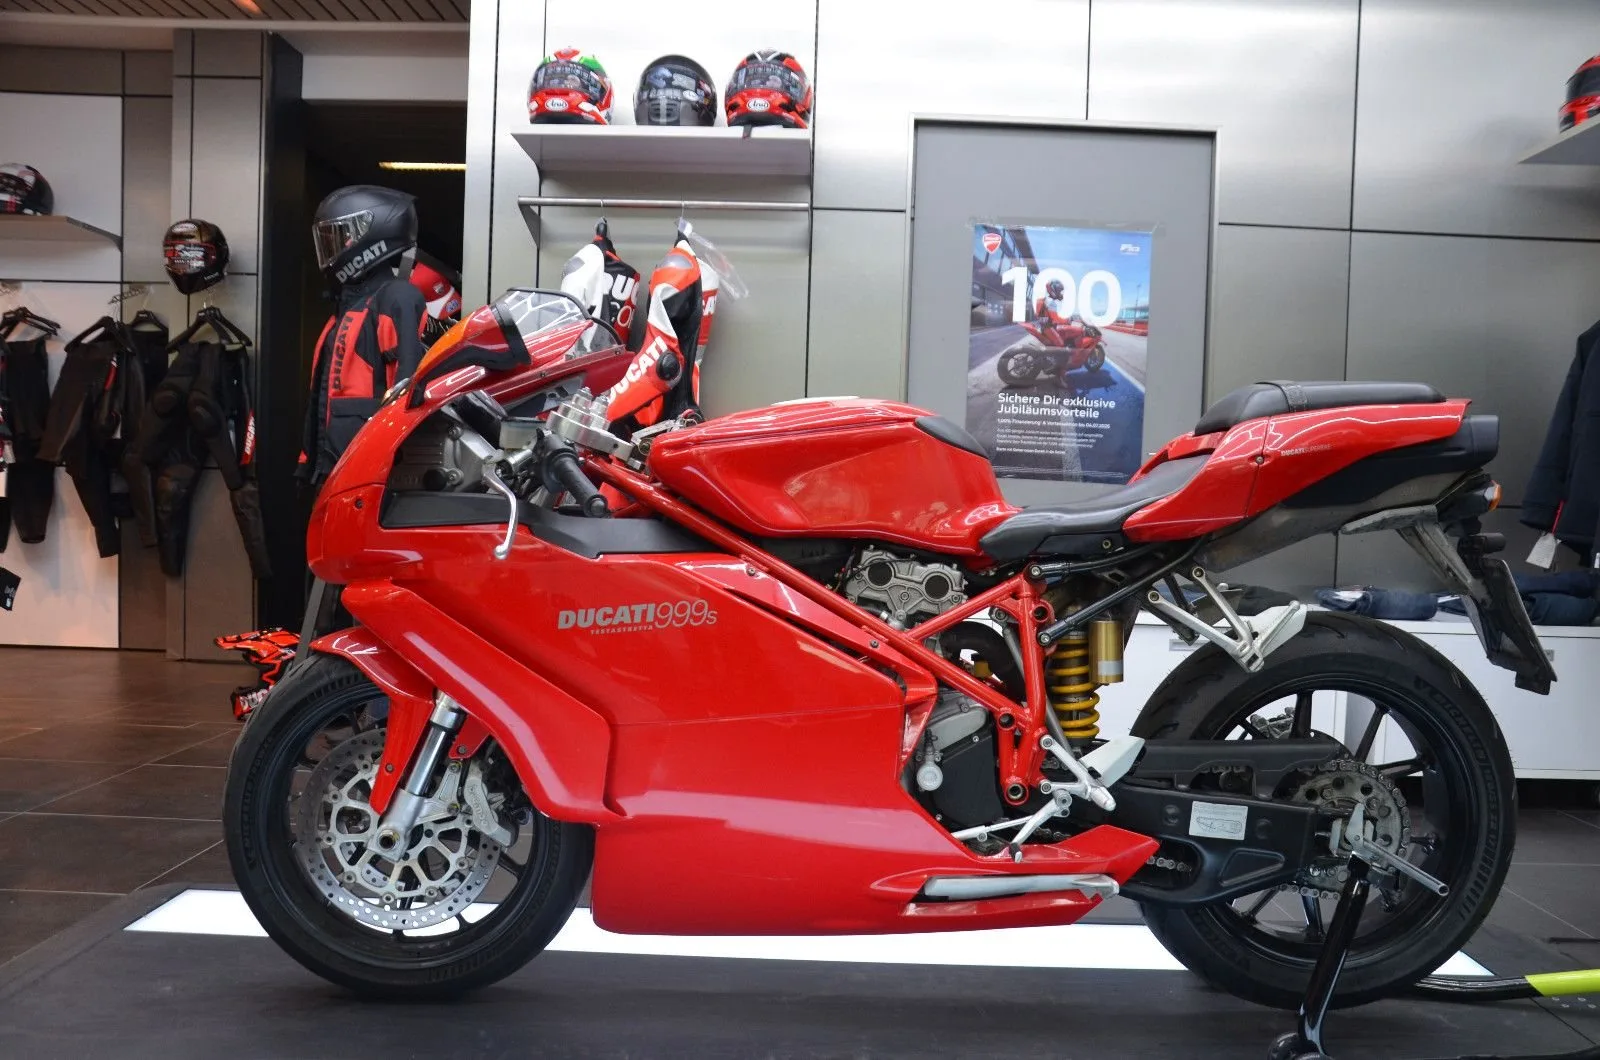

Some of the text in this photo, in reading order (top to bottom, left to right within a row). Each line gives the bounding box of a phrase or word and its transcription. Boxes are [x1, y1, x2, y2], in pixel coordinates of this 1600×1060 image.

[335, 239, 388, 284] DUCATI
[1001, 266, 1122, 327] 100
[333, 315, 353, 391] DUCATI
[997, 392, 1116, 409] Sichere Dir exklusive
[997, 403, 1100, 418] Jubiläumsvorteile
[557, 603, 656, 629] DUCATI
